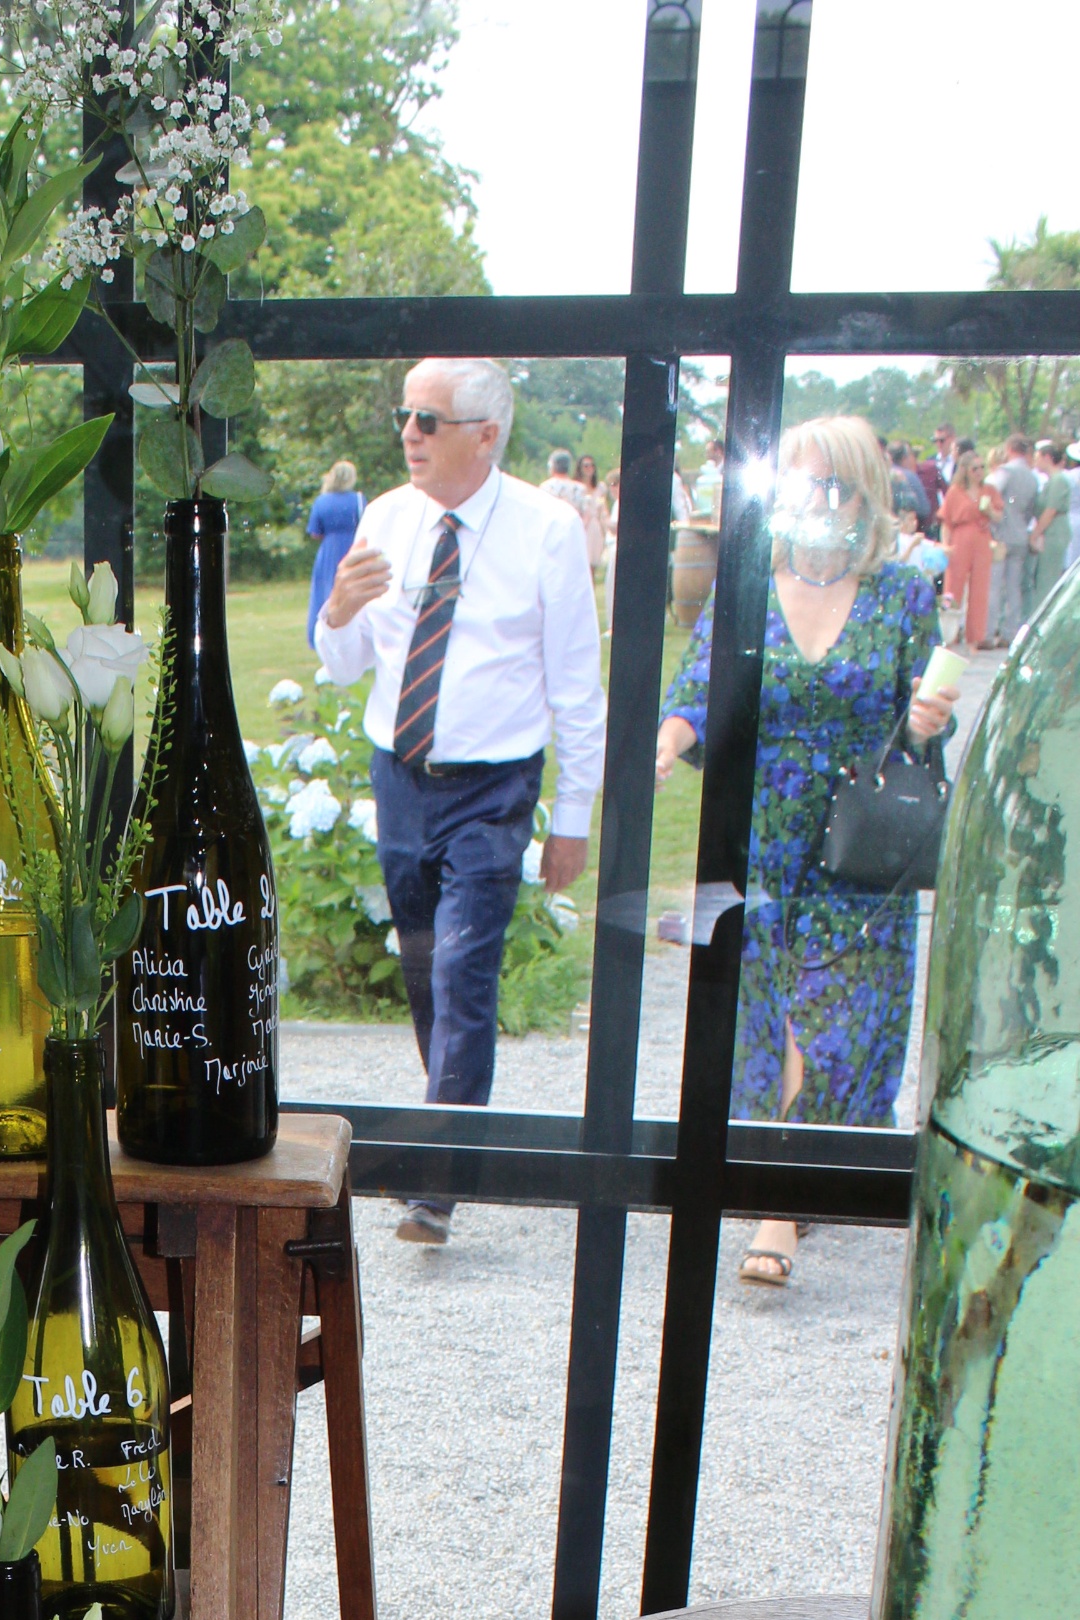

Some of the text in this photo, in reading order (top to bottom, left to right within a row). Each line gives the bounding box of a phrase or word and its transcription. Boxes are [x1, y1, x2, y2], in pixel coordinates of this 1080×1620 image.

[144, 873, 275, 931] Table 2
[132, 947, 189, 977] Alicia
[132, 982, 208, 1013] Christine
[22, 1366, 144, 1419] Table 6
[121, 1428, 162, 1470] Fred
